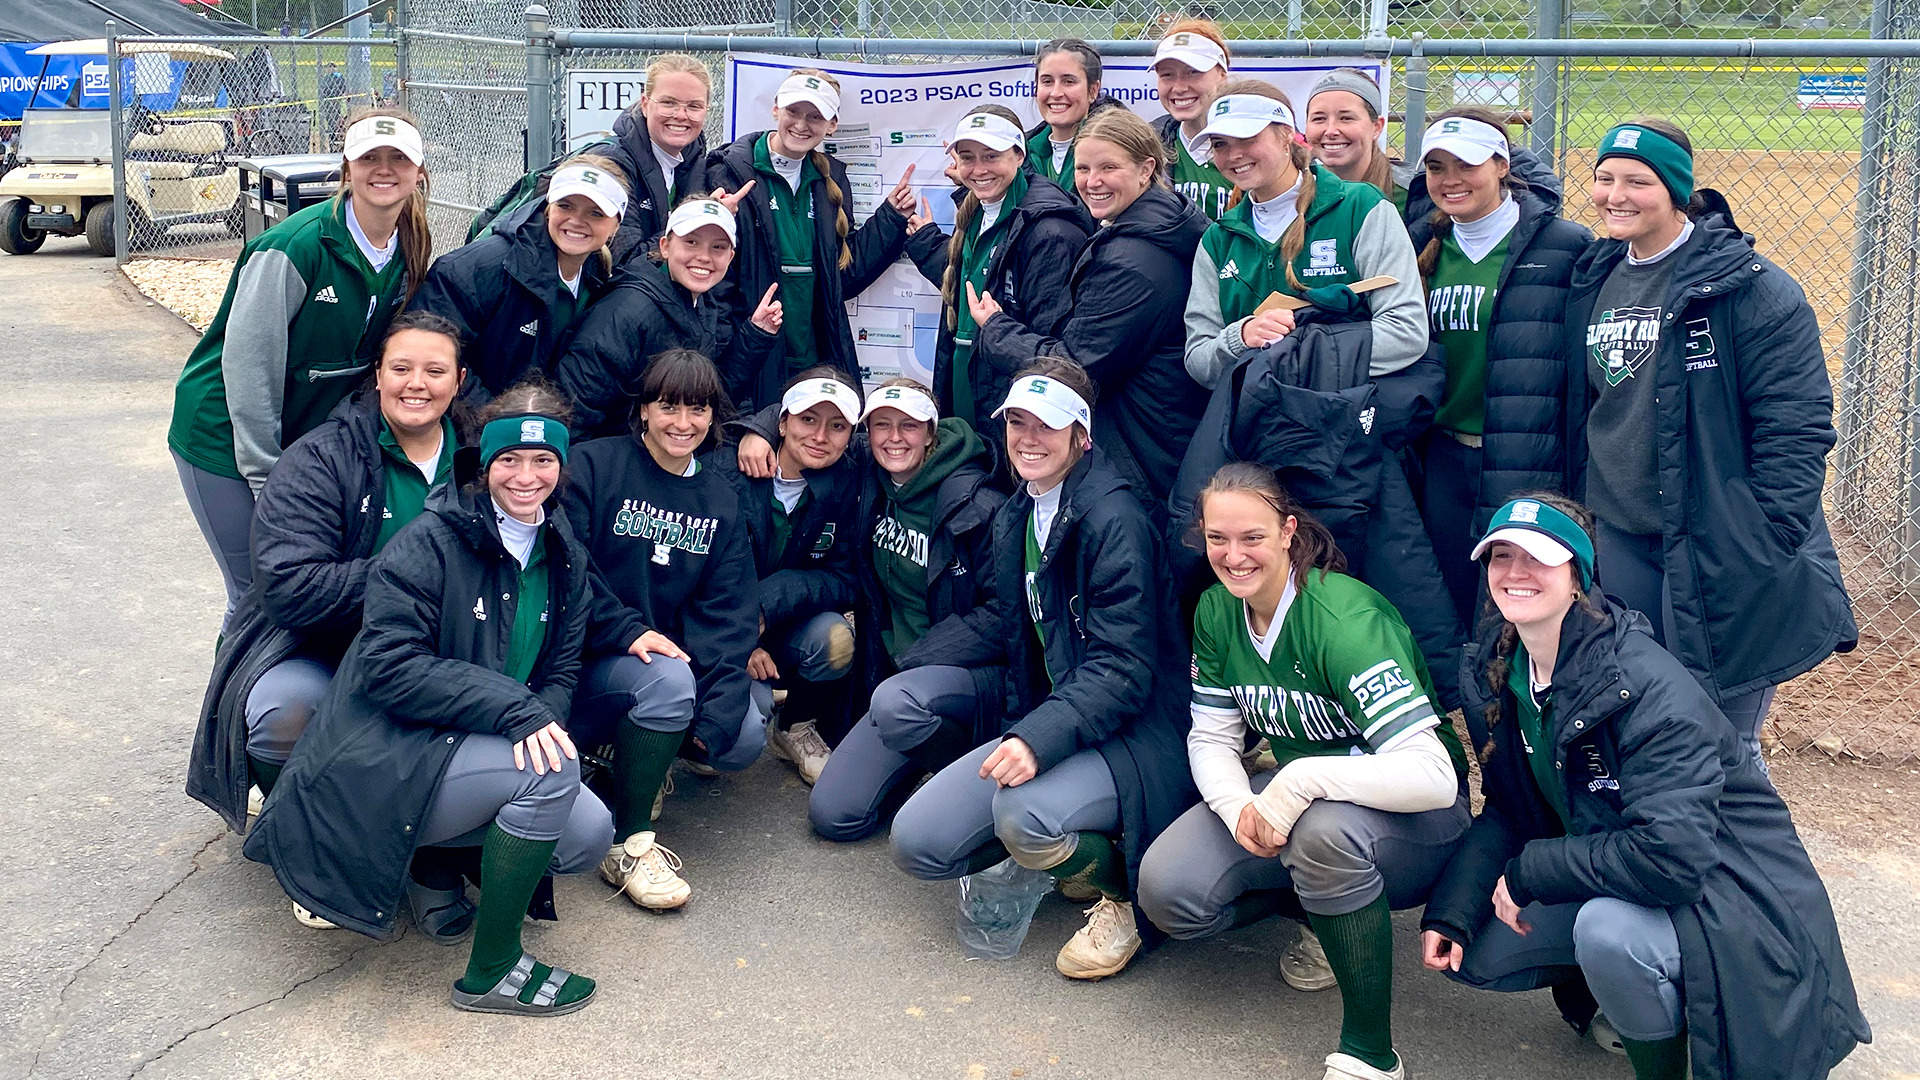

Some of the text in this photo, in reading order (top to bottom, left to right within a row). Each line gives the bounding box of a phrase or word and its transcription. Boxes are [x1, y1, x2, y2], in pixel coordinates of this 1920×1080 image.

[1173, 34, 1190, 46] S
[0, 75, 69, 92] PIONSHIPS
[804, 77, 820, 90] S
[860, 87, 918, 105] 2023
[925, 83, 983, 101] PSAC
[1215, 99, 1230, 117] S
[374, 120, 396, 135] S
[971, 116, 986, 128] S
[1441, 120, 1461, 134] S
[1613, 130, 1639, 150] S
[581, 170, 599, 185] S
[874, 180, 879, 188] 5
[703, 203, 719, 215] S
[1309, 238, 1337, 269] S
[1302, 265, 1347, 278] SOFTBALL
[314, 294, 339, 304] adidas
[901, 290, 913, 298] L10
[1586, 319, 1661, 346] SLIPPERY RO
[1600, 340, 1644, 352] SOFTBALL
[1607, 349, 1625, 368] S
[821, 383, 837, 395] S
[885, 388, 901, 399] S
[1027, 379, 1048, 394] S
[1364, 406, 1376, 435] adidas
[519, 420, 546, 443] S
[1508, 501, 1541, 524] S
[686, 515, 719, 530] ROCK
[650, 543, 671, 566] S
[1353, 667, 1412, 710] PSAC
[1290, 690, 1363, 742] ROCK
